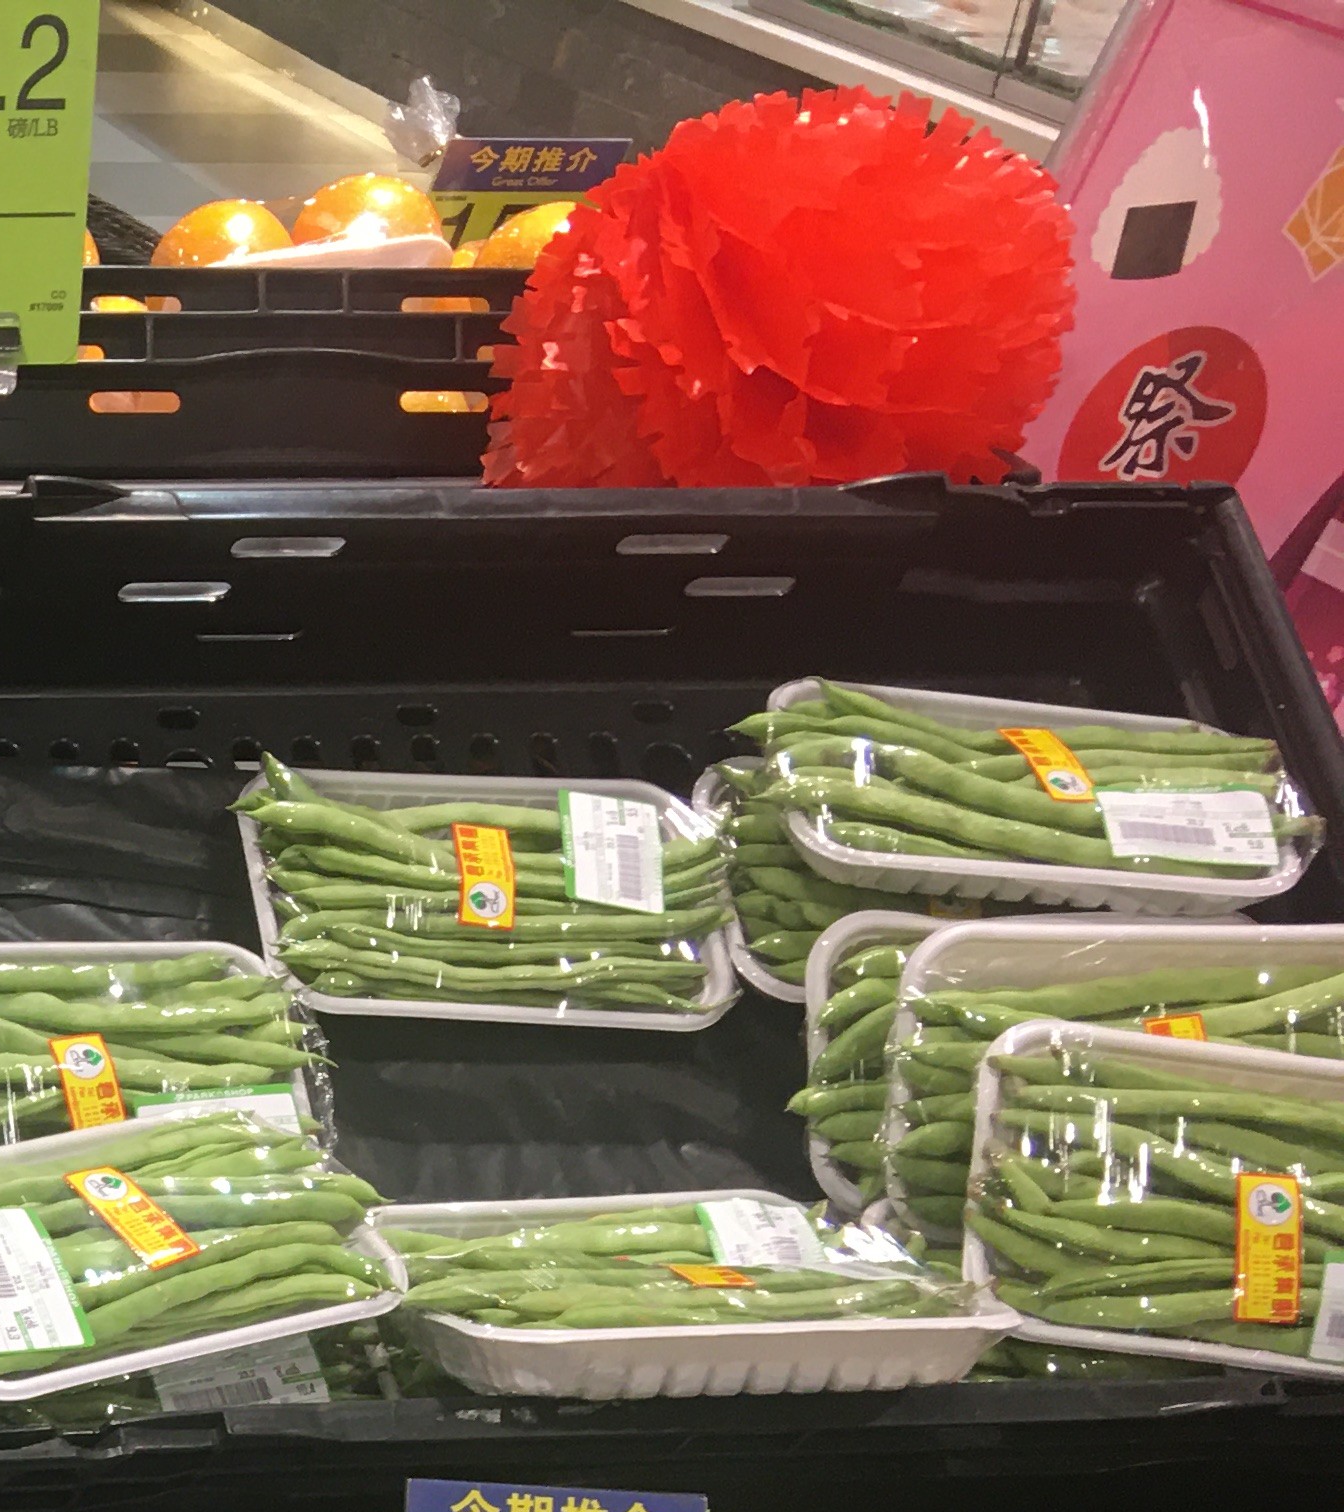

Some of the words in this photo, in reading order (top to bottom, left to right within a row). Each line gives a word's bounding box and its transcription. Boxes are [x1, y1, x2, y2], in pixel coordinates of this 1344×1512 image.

[470, 145, 598, 173] 今期推介
[1100, 352, 1234, 478] 祭
